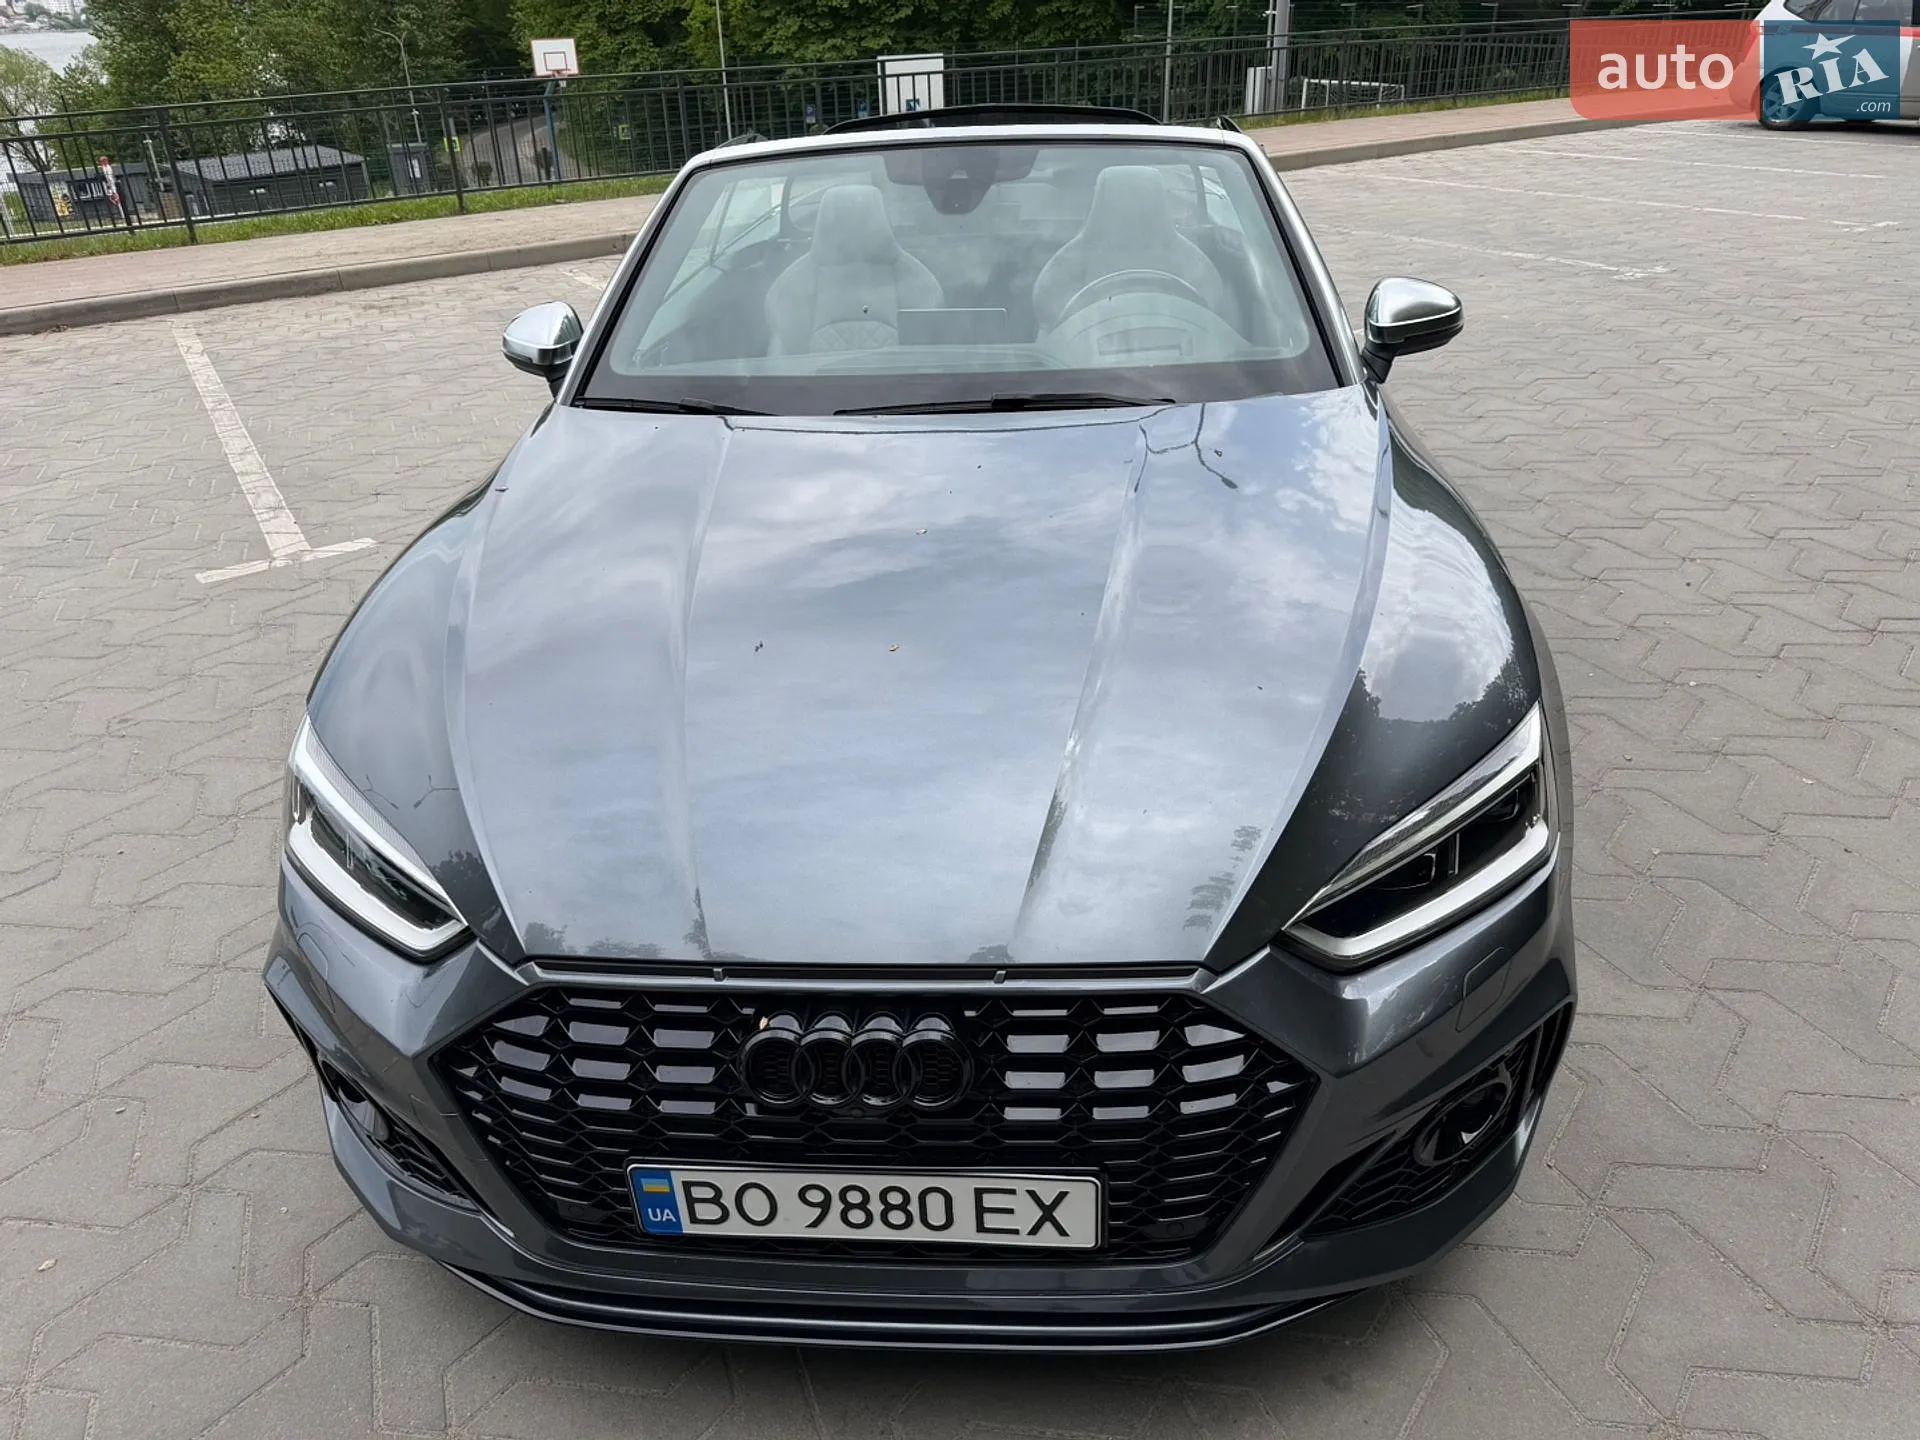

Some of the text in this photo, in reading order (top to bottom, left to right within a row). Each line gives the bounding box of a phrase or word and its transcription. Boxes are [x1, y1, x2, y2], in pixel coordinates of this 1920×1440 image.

[648, 1208, 676, 1222] UA
[681, 1180, 1071, 1237] BO 9880 EX
